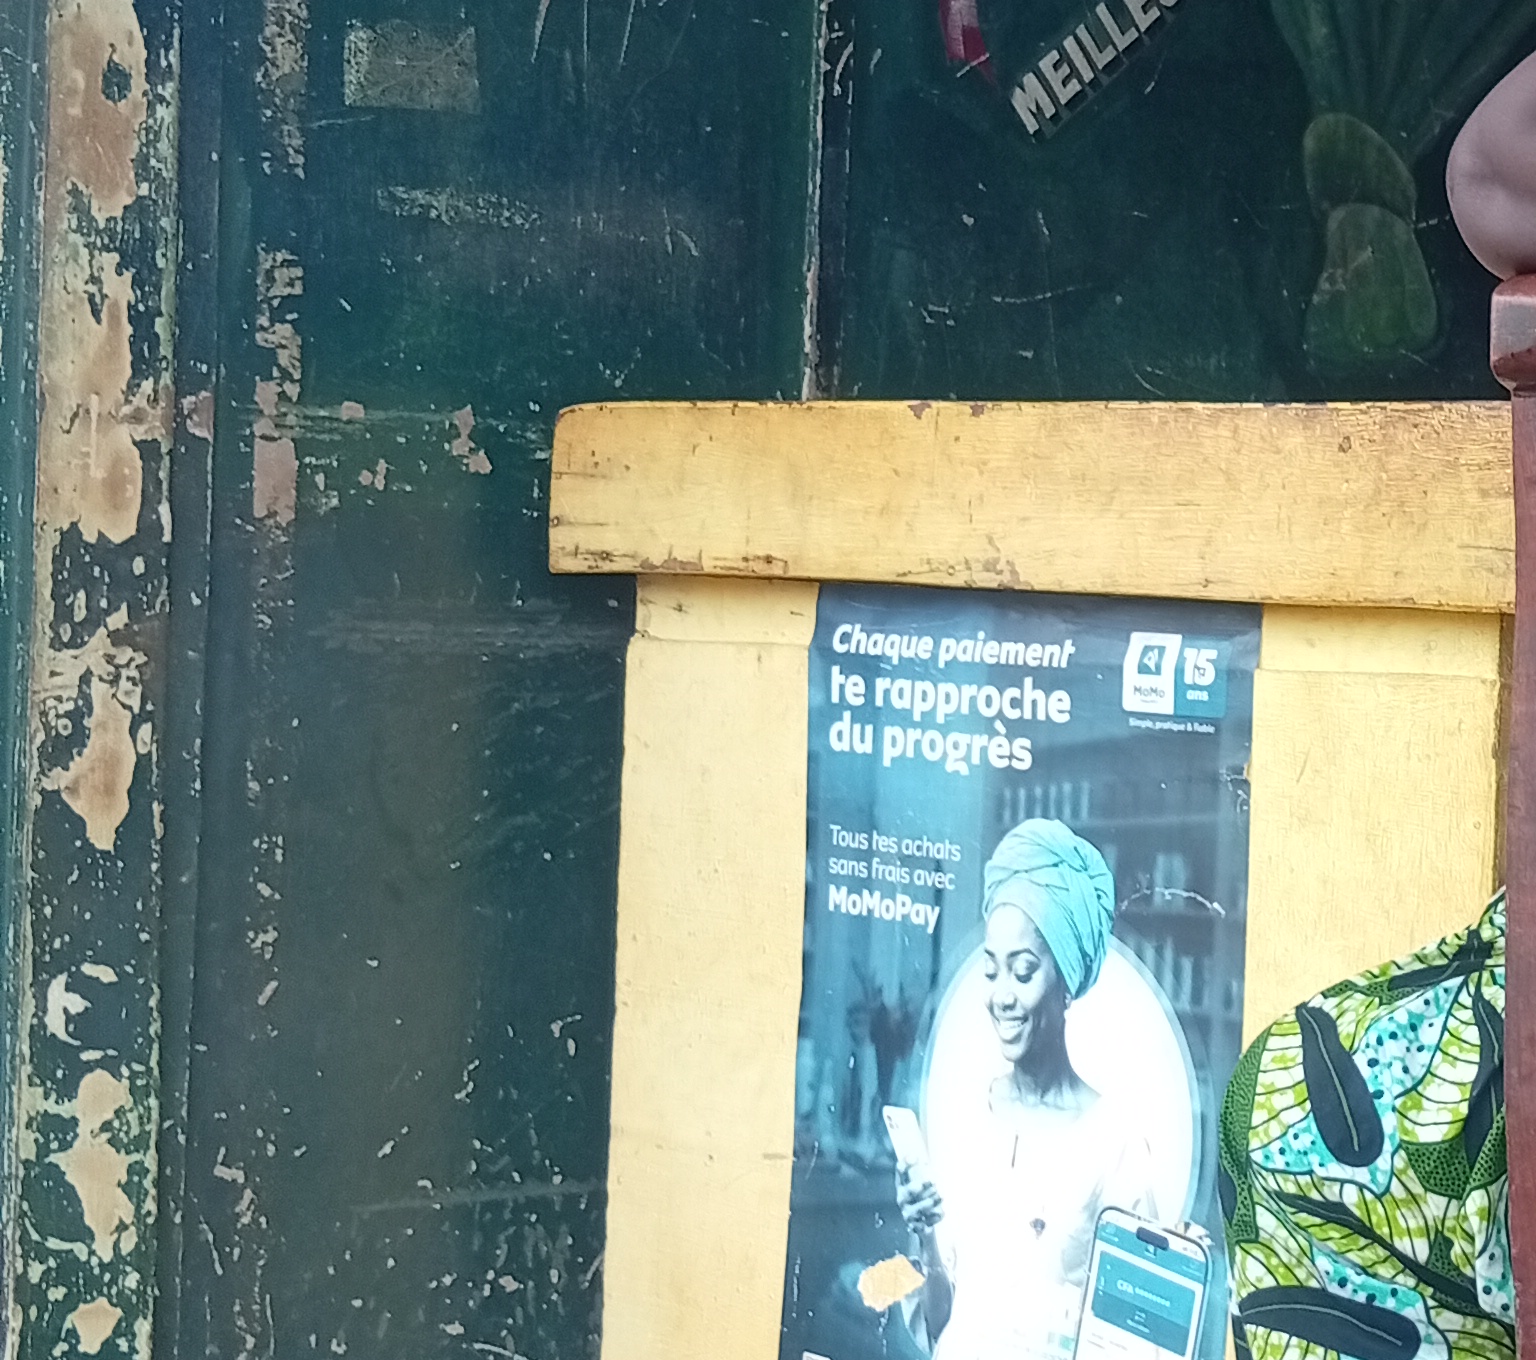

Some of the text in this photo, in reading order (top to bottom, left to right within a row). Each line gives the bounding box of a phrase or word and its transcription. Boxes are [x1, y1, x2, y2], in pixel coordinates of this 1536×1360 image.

[832, 623, 1076, 669] Chaque paiement
[1183, 647, 1218, 686] 15
[830, 666, 1072, 724] te rapproche
[1133, 685, 1166, 699] MoMo
[1186, 689, 1209, 702] ans
[829, 710, 1033, 776] du progrès
[829, 824, 962, 863] Tous tes achats
[828, 857, 956, 890] sans frais avec
[828, 883, 941, 934] MoMoPay
